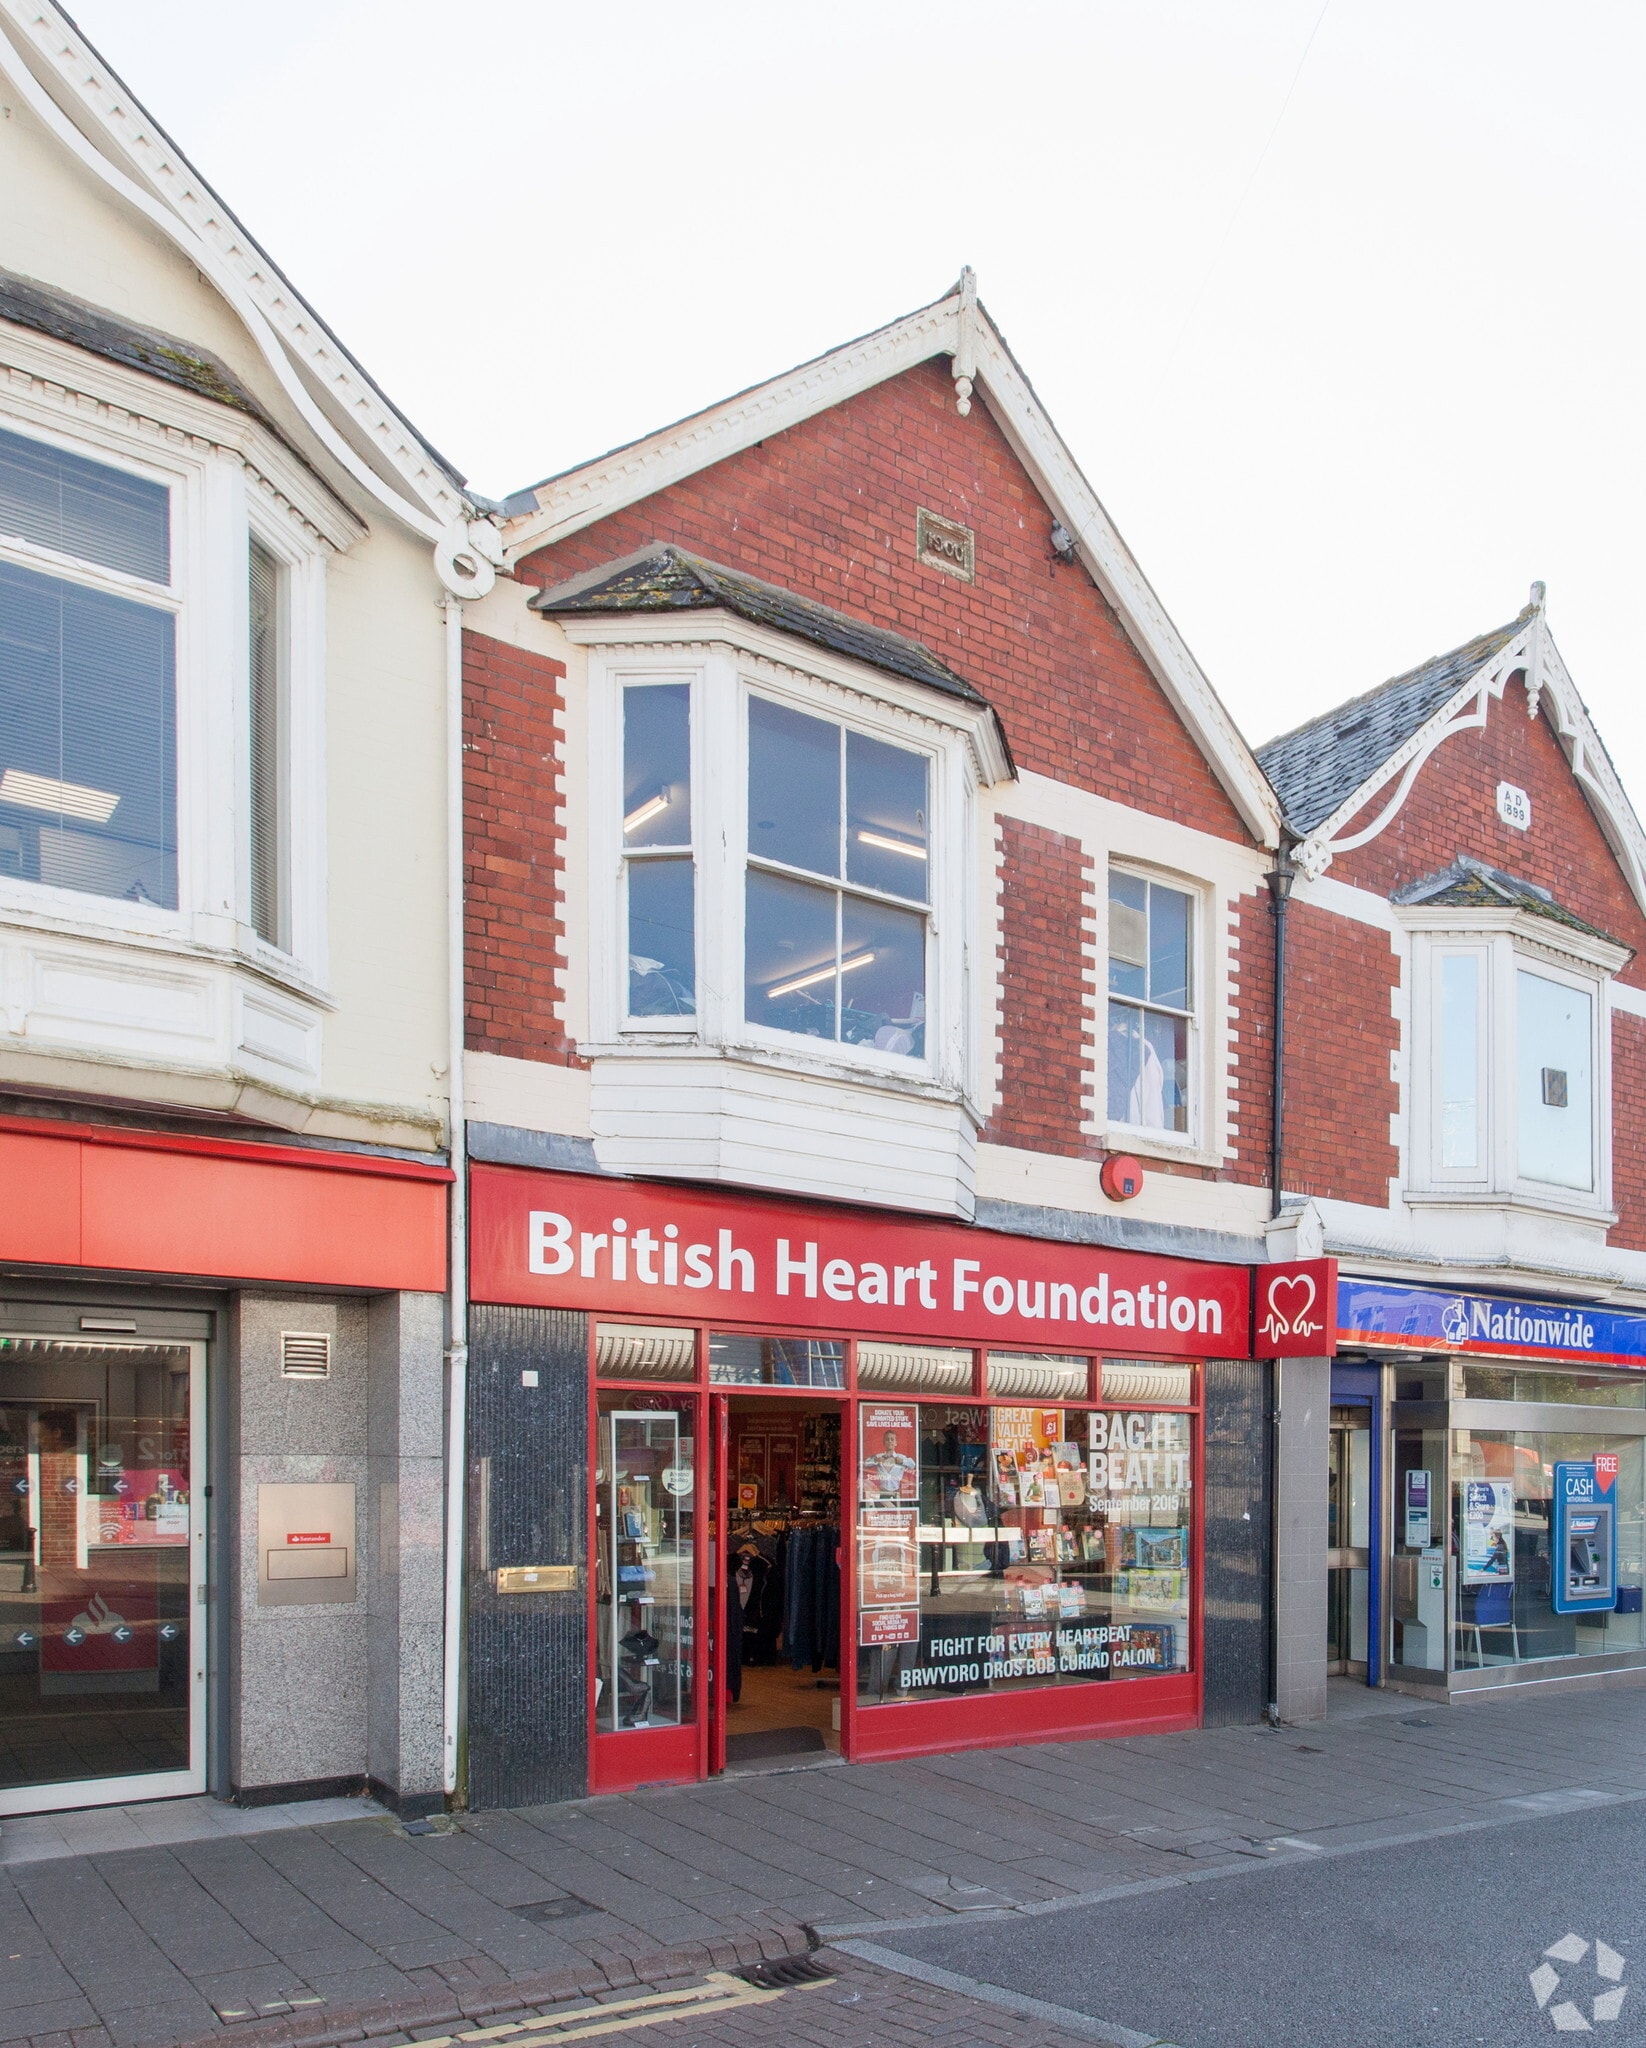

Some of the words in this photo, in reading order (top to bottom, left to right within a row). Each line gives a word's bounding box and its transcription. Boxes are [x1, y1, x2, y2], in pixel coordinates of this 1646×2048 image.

[1503, 802, 1525, 821] 1899
[528, 1211, 755, 1293] British
[776, 1238, 937, 1310] Heart
[953, 1258, 1223, 1335] Foundation
[1471, 1301, 1594, 1349] Nationwide
[998, 1407, 1034, 1423] GREAT
[997, 1423, 1033, 1438] VALUE
[1045, 1421, 1057, 1435] £1
[1089, 1412, 1146, 1452] BAG
[1151, 1413, 1180, 1452] IT.
[1089, 1452, 1159, 1491] BEAT
[1165, 1453, 1192, 1490] IT.
[1595, 1457, 1617, 1473] FREE
[1565, 1478, 1594, 1496] CASH
[1089, 1495, 1151, 1516] September
[1152, 1494, 1179, 1511] 2015
[931, 1637, 975, 1658] FIGHT
[978, 1635, 1006, 1654] FOR
[1009, 1631, 1053, 1651] EVERY
[1056, 1625, 1133, 1648] HEARTBEAT
[900, 1663, 979, 1689] BRWYDRO
[983, 1659, 1023, 1681] DROS
[1026, 1655, 1056, 1675] BOB
[1059, 1651, 1110, 1672] CURIAD
[1112, 1648, 1156, 1668] CALON
